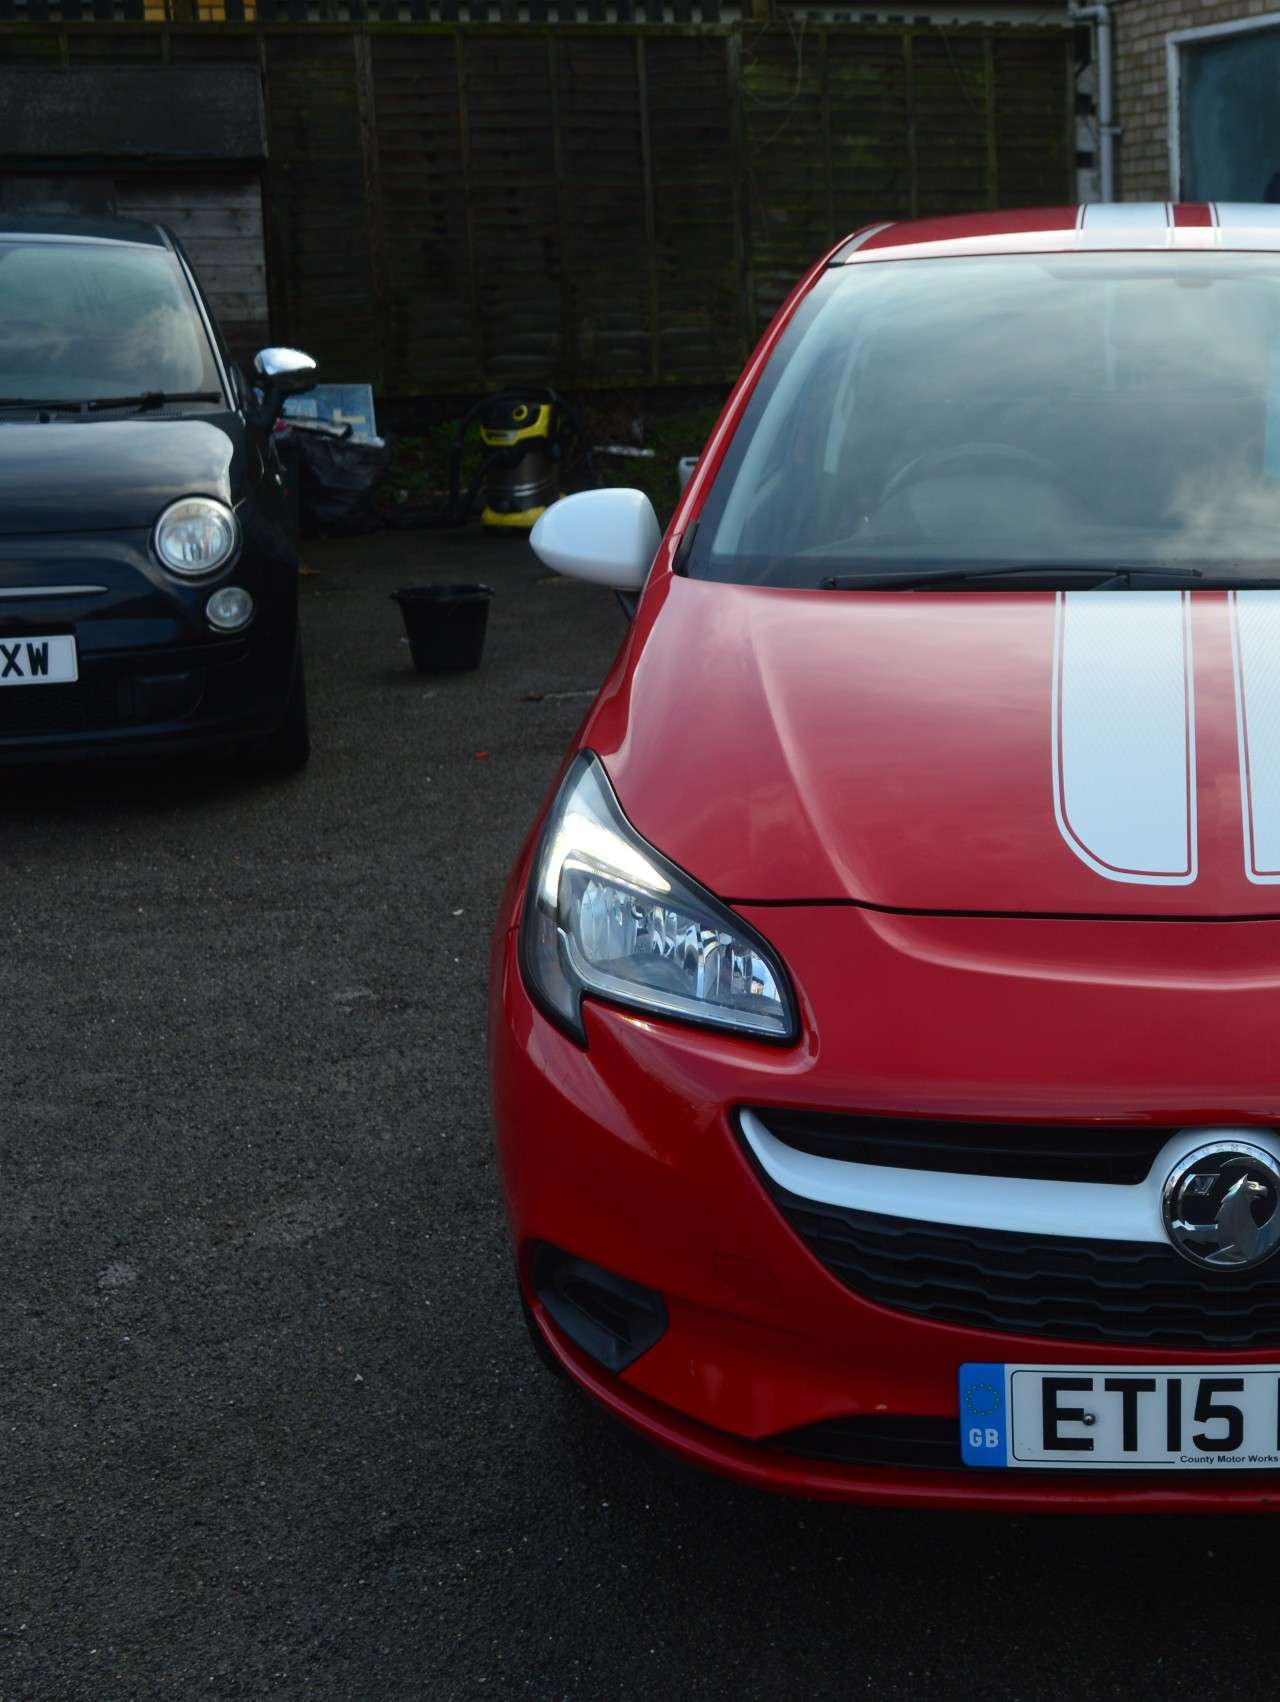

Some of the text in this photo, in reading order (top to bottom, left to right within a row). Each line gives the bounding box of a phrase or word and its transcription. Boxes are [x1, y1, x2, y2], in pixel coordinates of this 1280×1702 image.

[0, 643, 49, 678] XW
[1042, 1377, 1244, 1452] ET15
[969, 1428, 999, 1448] GB
[1180, 1455, 1214, 1464] County
[1218, 1454, 1246, 1463] Motor
[1248, 1454, 1279, 1462] Works
